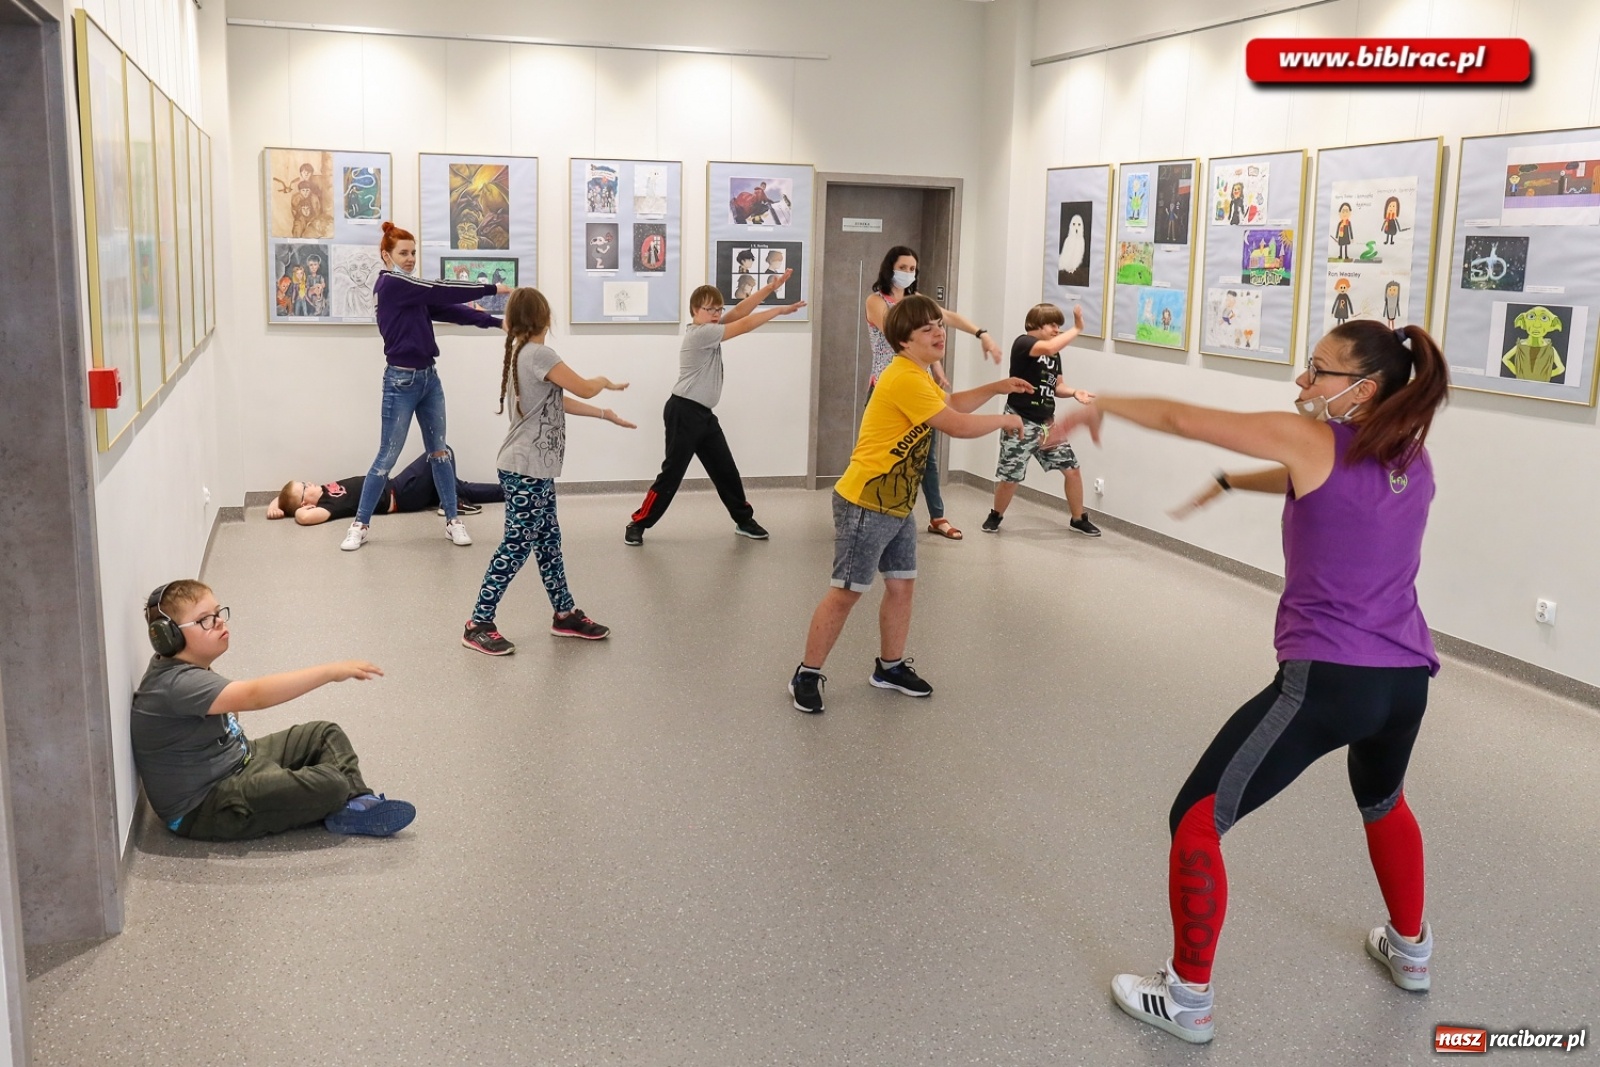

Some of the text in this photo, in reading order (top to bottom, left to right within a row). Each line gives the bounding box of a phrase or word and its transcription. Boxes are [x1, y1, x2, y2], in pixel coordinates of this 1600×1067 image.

[1179, 848, 1217, 968] FOCUS
[1402, 965, 1427, 973] adida
[1194, 1014, 1212, 1025] adid
